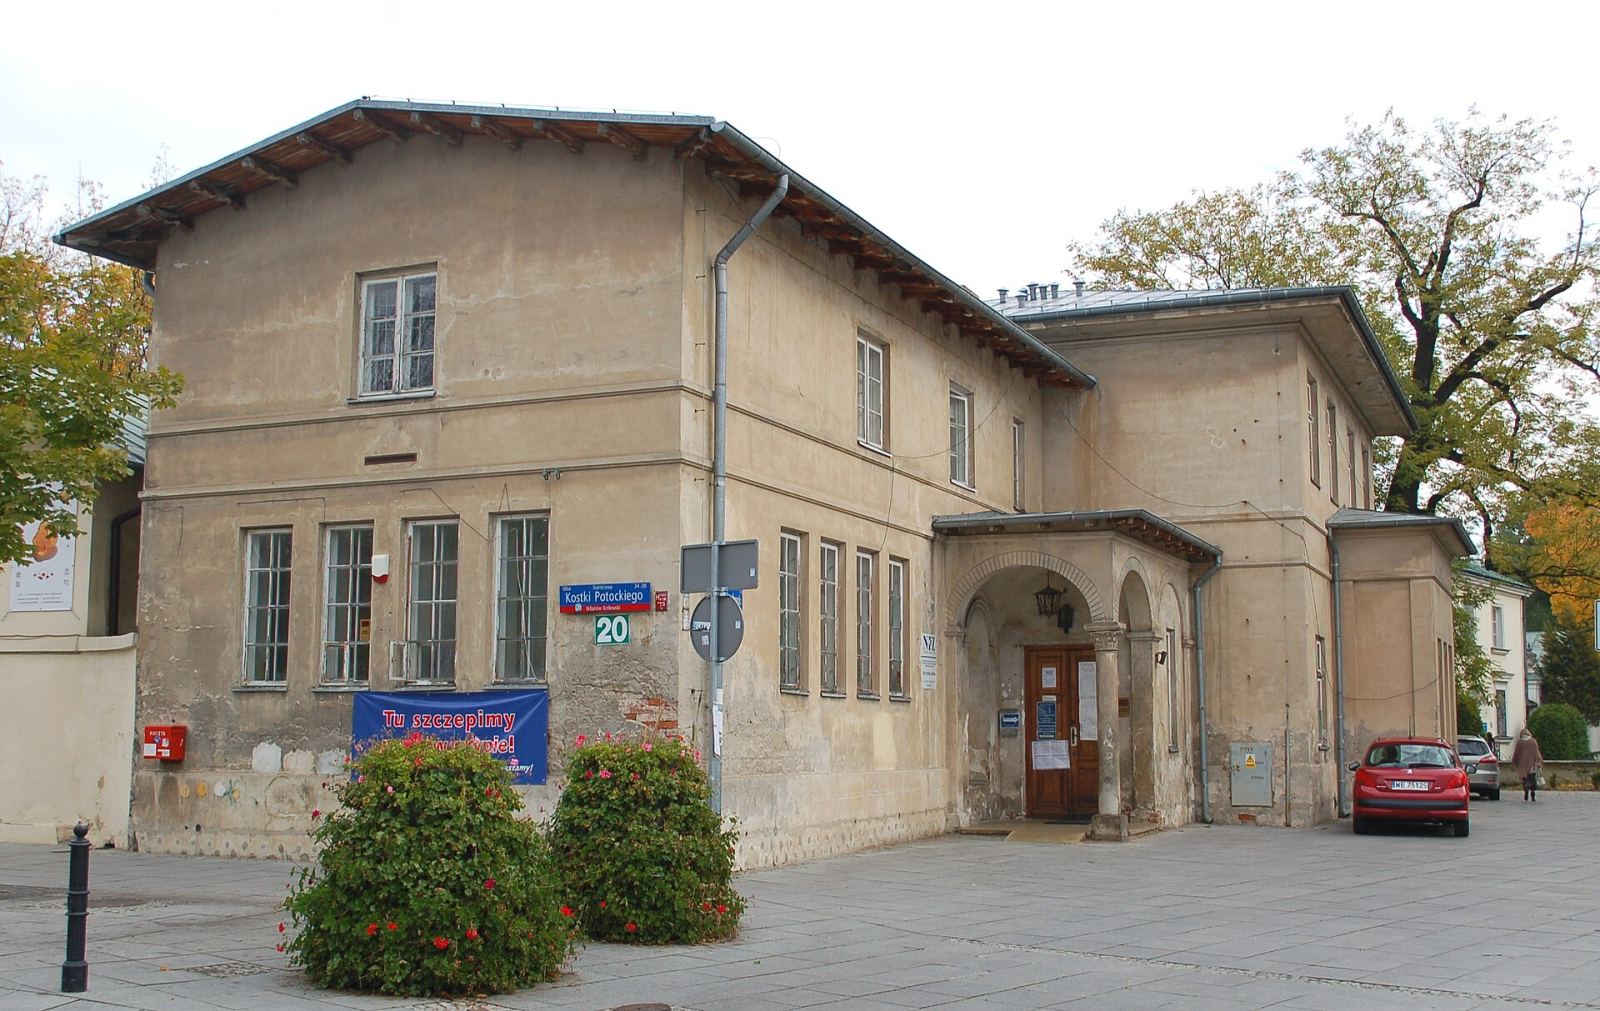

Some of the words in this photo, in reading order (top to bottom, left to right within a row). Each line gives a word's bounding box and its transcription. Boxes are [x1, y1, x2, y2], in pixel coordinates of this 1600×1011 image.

[565, 591, 591, 603] Kostki
[594, 589, 643, 604] Potockiego
[597, 616, 628, 643] 20
[383, 710, 404, 728] Tu
[412, 709, 516, 733] szczepimy
